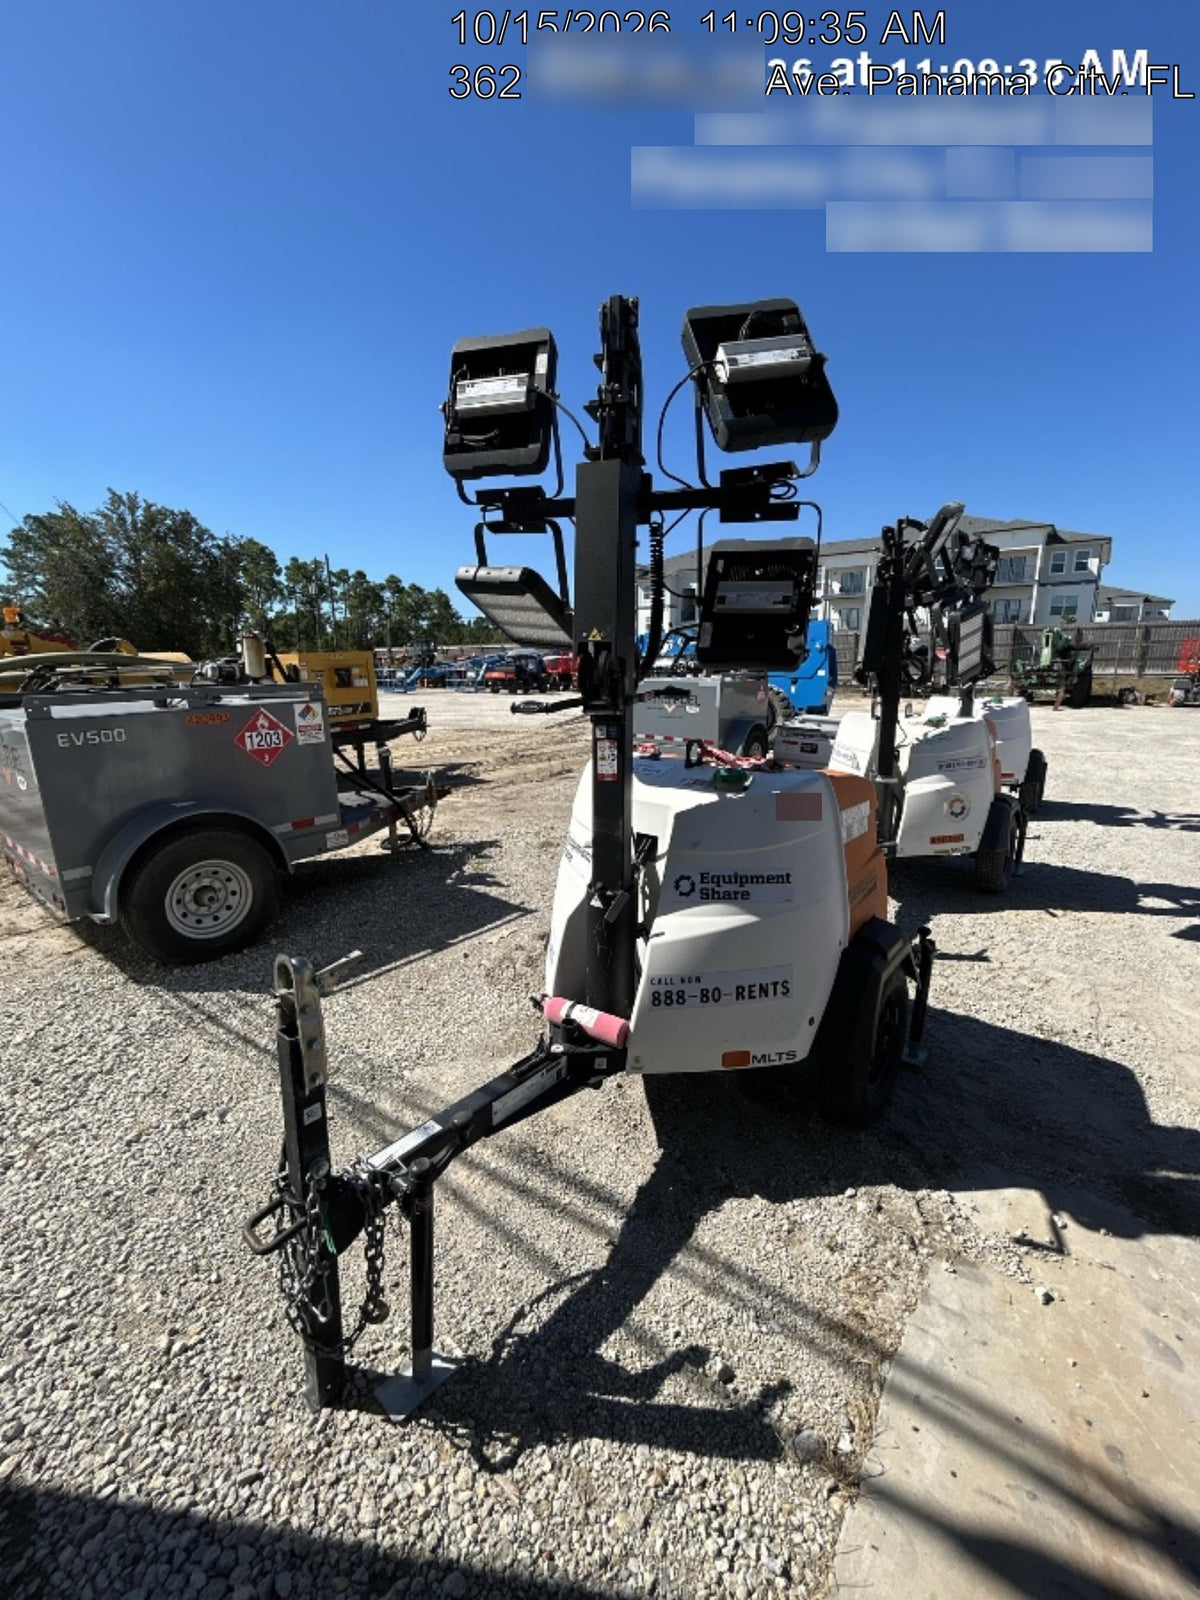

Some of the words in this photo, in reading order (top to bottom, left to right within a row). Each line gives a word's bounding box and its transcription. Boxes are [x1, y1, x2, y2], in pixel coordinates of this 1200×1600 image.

[57, 728, 127, 748] EV500
[247, 731, 283, 750] 1203
[699, 871, 792, 888] Equipment
[699, 887, 751, 901] Share
[650, 976, 676, 986] CALL
[651, 980, 791, 1008] 888-80-RENTS
[751, 1050, 798, 1066] MLTS
